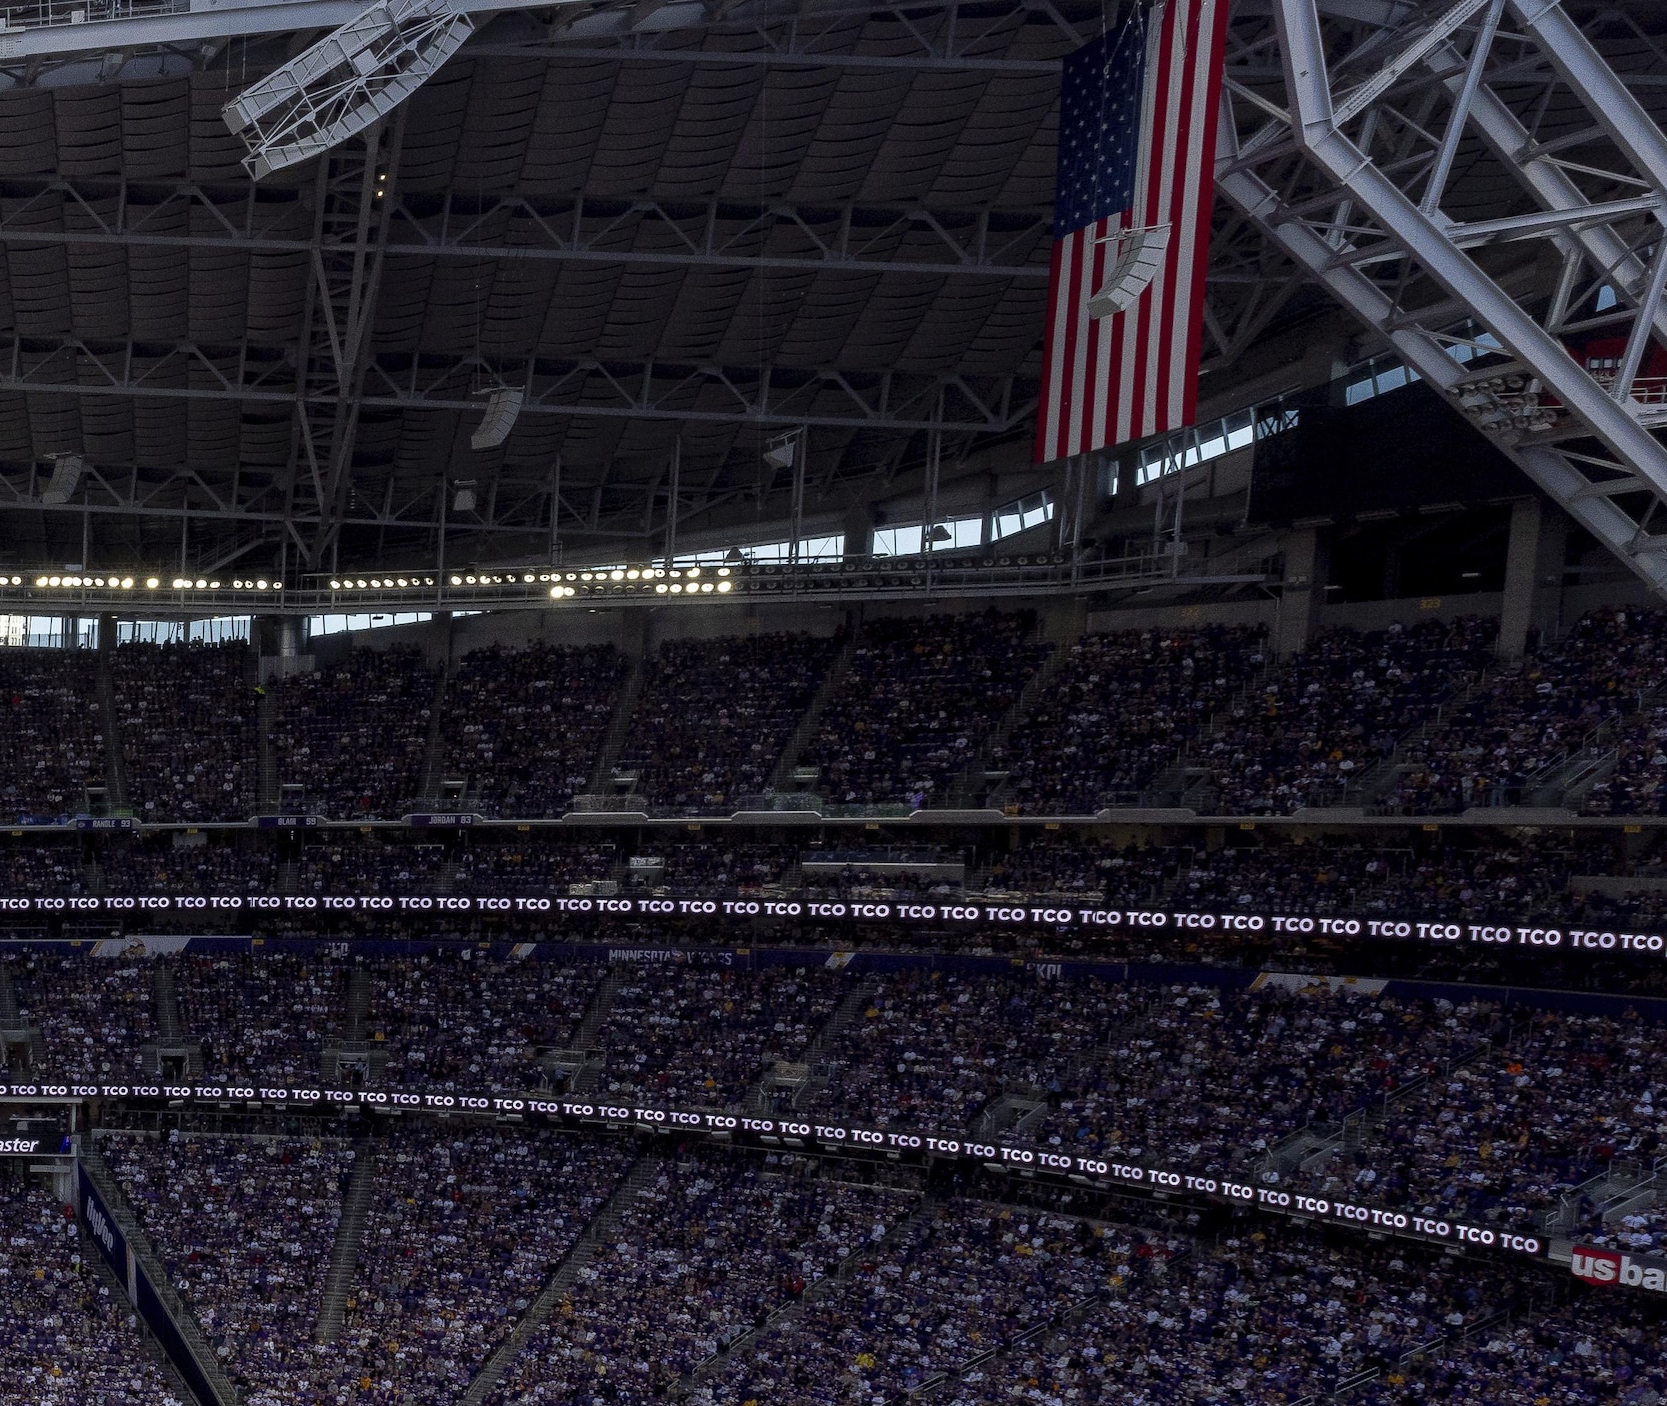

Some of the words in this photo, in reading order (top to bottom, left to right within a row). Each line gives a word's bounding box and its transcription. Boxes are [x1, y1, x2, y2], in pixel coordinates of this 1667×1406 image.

[34, 898, 66, 909] TCO
[174, 896, 207, 908] TCO
[322, 897, 356, 908] TCO
[476, 897, 511, 910] TCO
[678, 900, 717, 913] TCO
[850, 904, 890, 917] TCO
[1030, 908, 1072, 923] TCO
[1220, 915, 1264, 930] TCO
[1416, 923, 1461, 940] TCO
[1619, 934, 1663, 950] TCO
[132, 1086, 159, 1096] TCO
[424, 1095, 455, 1106] TCO
[562, 1103, 594, 1116] TCO
[814, 1125, 846, 1139] TCO
[926, 1137, 960, 1153] TCO
[1037, 1152, 1072, 1168] TCO
[1147, 1169, 1181, 1186] TCO
[1257, 1188, 1290, 1206] TCO
[1371, 1209, 1407, 1228] TCO
[1500, 1233, 1539, 1253] TCO
